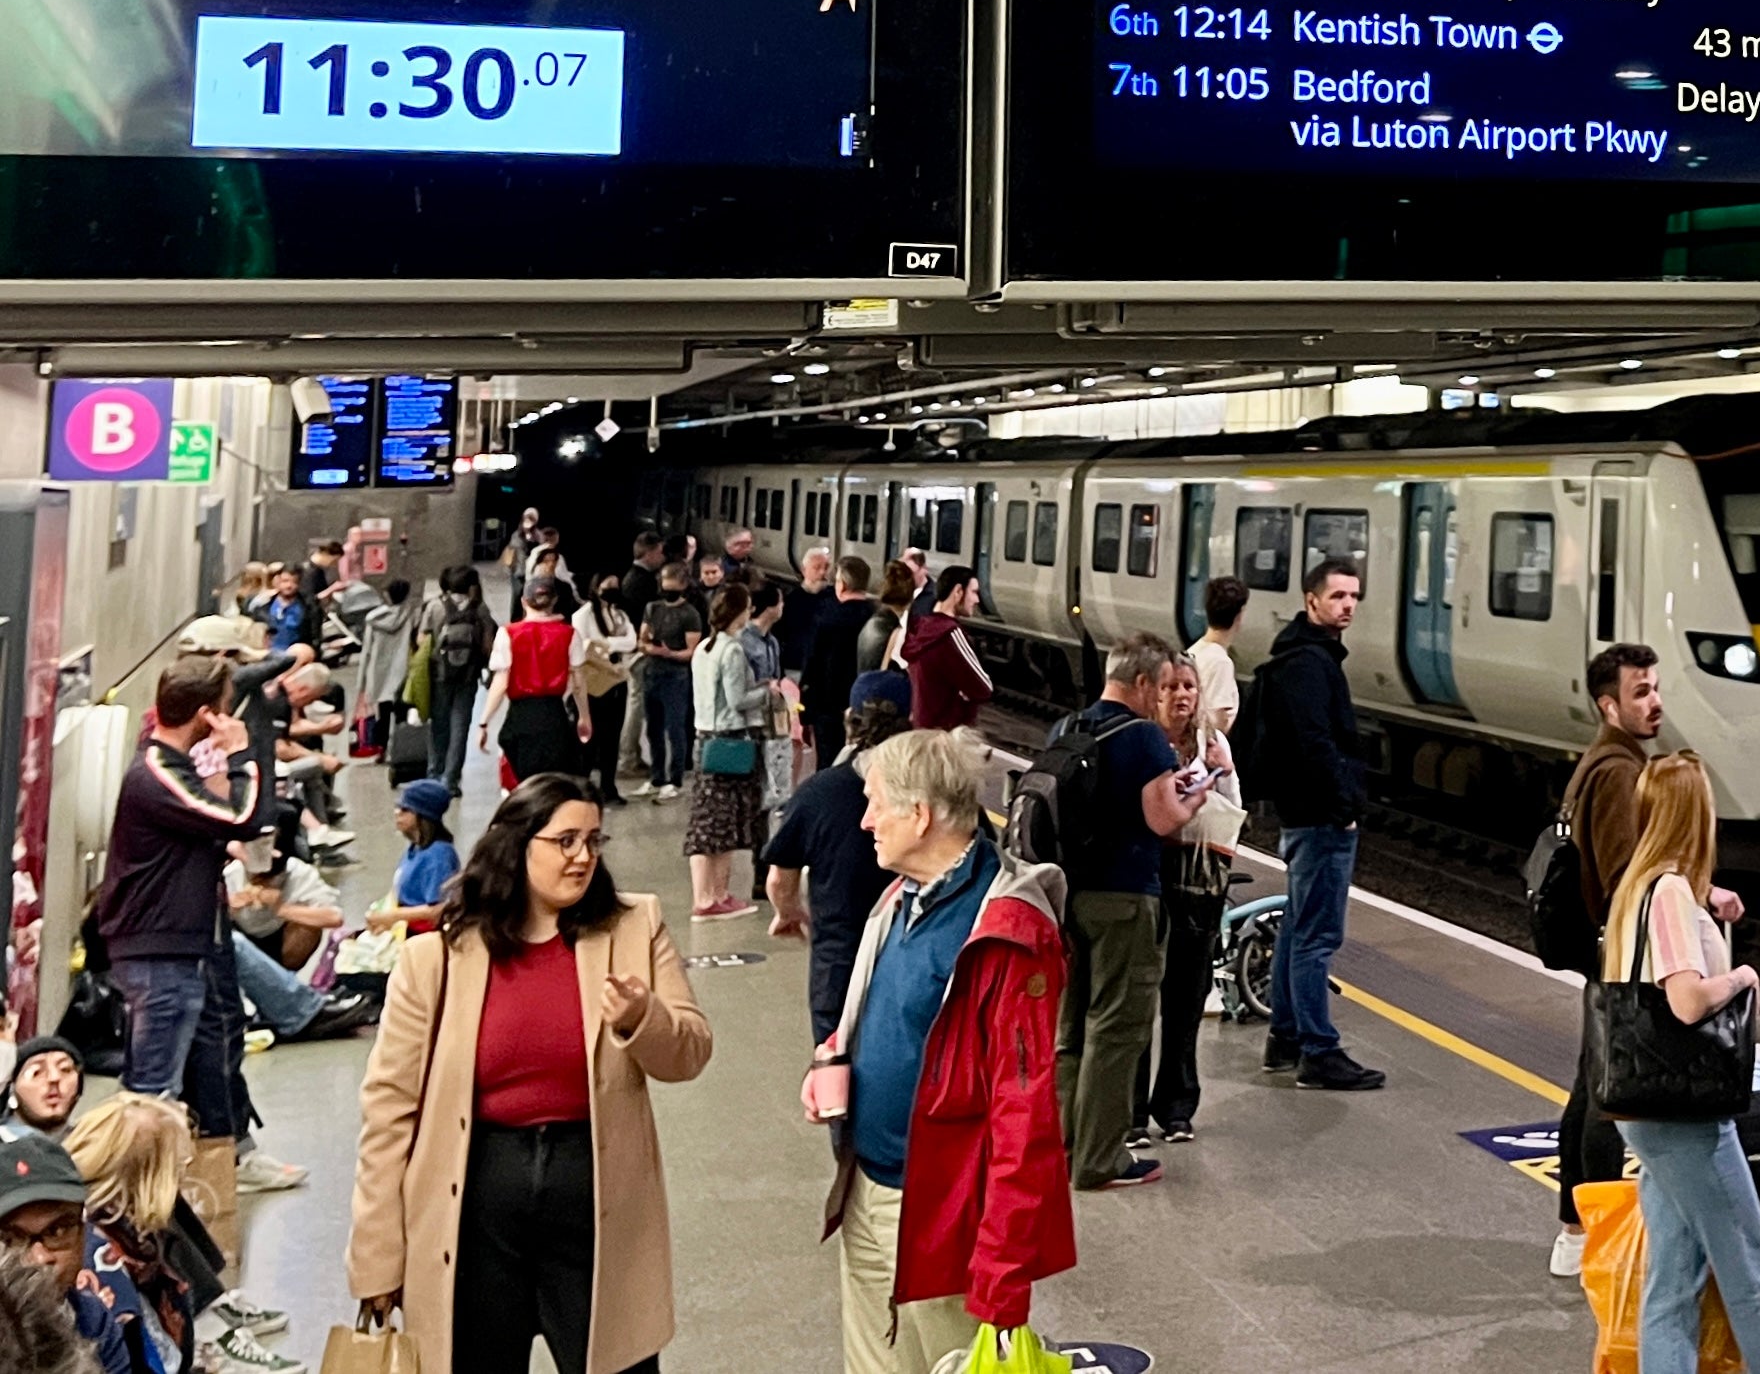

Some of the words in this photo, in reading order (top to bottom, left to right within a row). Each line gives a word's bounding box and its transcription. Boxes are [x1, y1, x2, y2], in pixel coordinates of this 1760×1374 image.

[1109, 3, 1159, 37] 6th
[1173, 5, 1273, 41] 12:14
[1293, 9, 1421, 46] Kentish
[1428, 15, 1518, 50] Town
[1693, 27, 1732, 58] 43
[1108, 63, 1158, 97] 7th
[1173, 64, 1270, 101] 11:05
[1293, 69, 1431, 105] Bedford
[1289, 114, 1341, 148] via
[1351, 114, 1453, 149] Luton
[1458, 118, 1577, 160] Airport
[1585, 120, 1668, 163] Pkwy
[906, 251, 941, 269] D47
[91, 402, 135, 455] B
